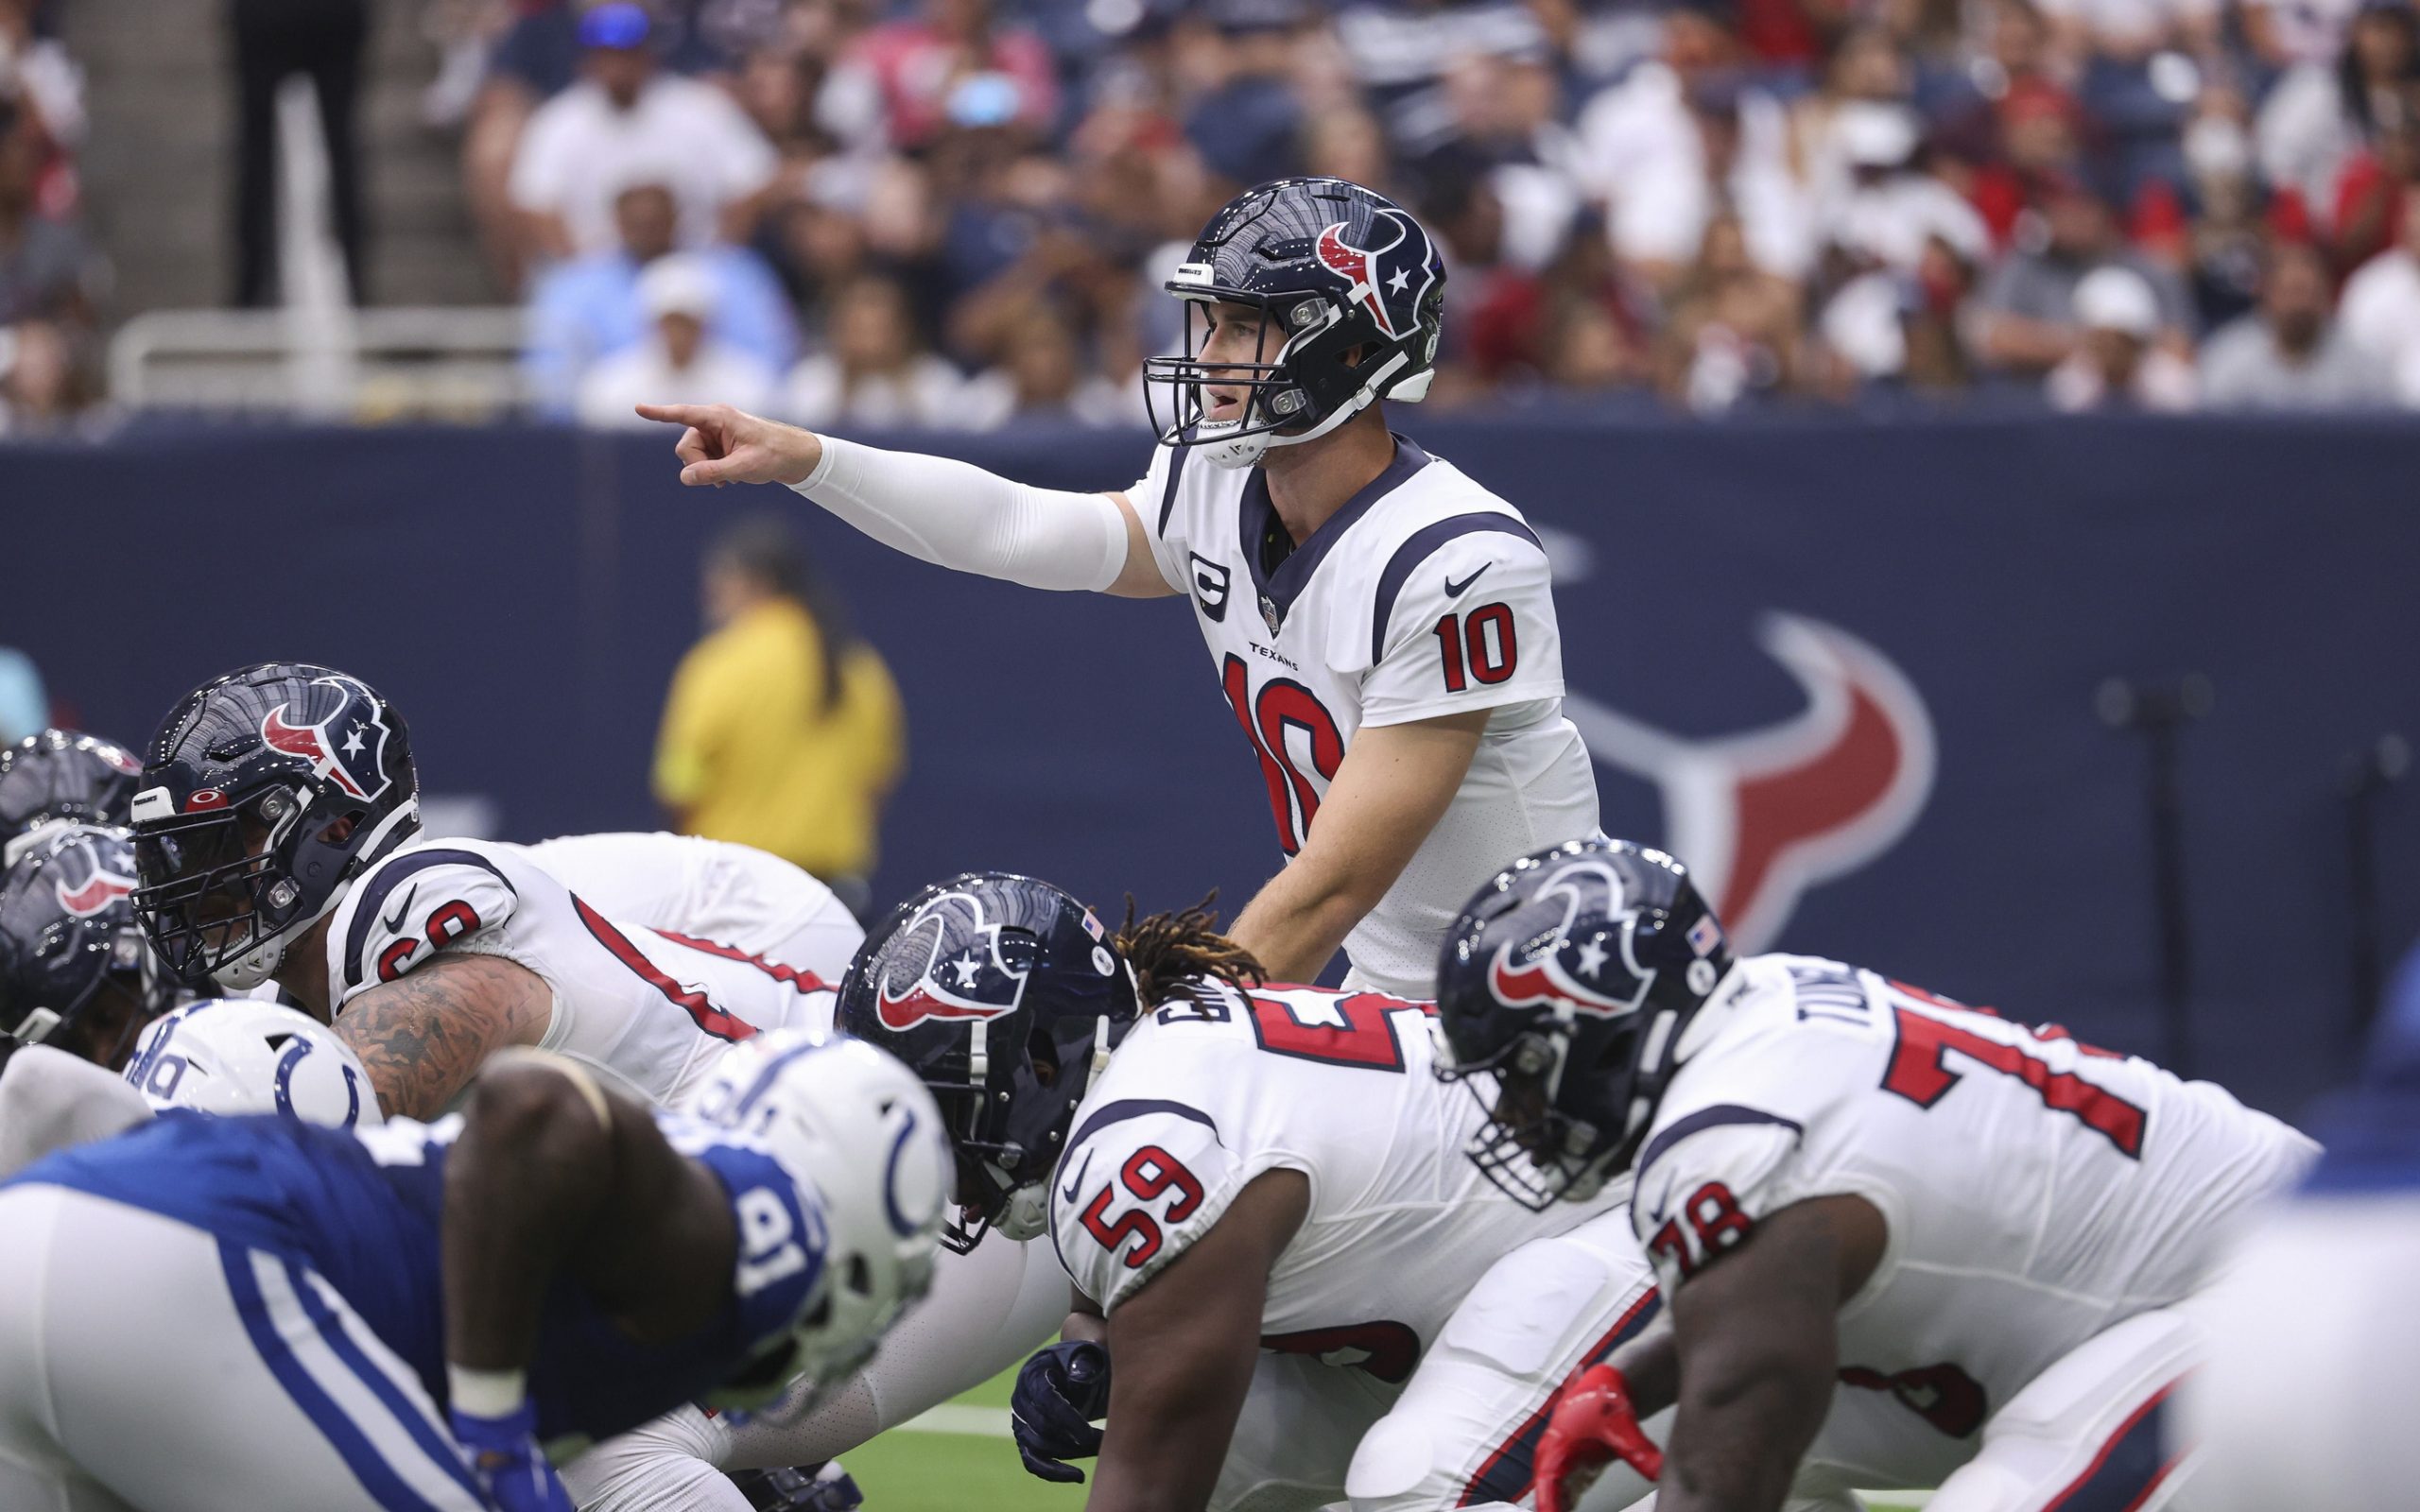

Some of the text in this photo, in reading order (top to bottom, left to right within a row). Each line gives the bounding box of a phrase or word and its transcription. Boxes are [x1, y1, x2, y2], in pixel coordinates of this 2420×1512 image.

[1248, 641, 1299, 671] TEXANS
[1431, 600, 1519, 694] 10
[1078, 1144, 1205, 1270] 59
[1648, 1179, 1753, 1279] 78
